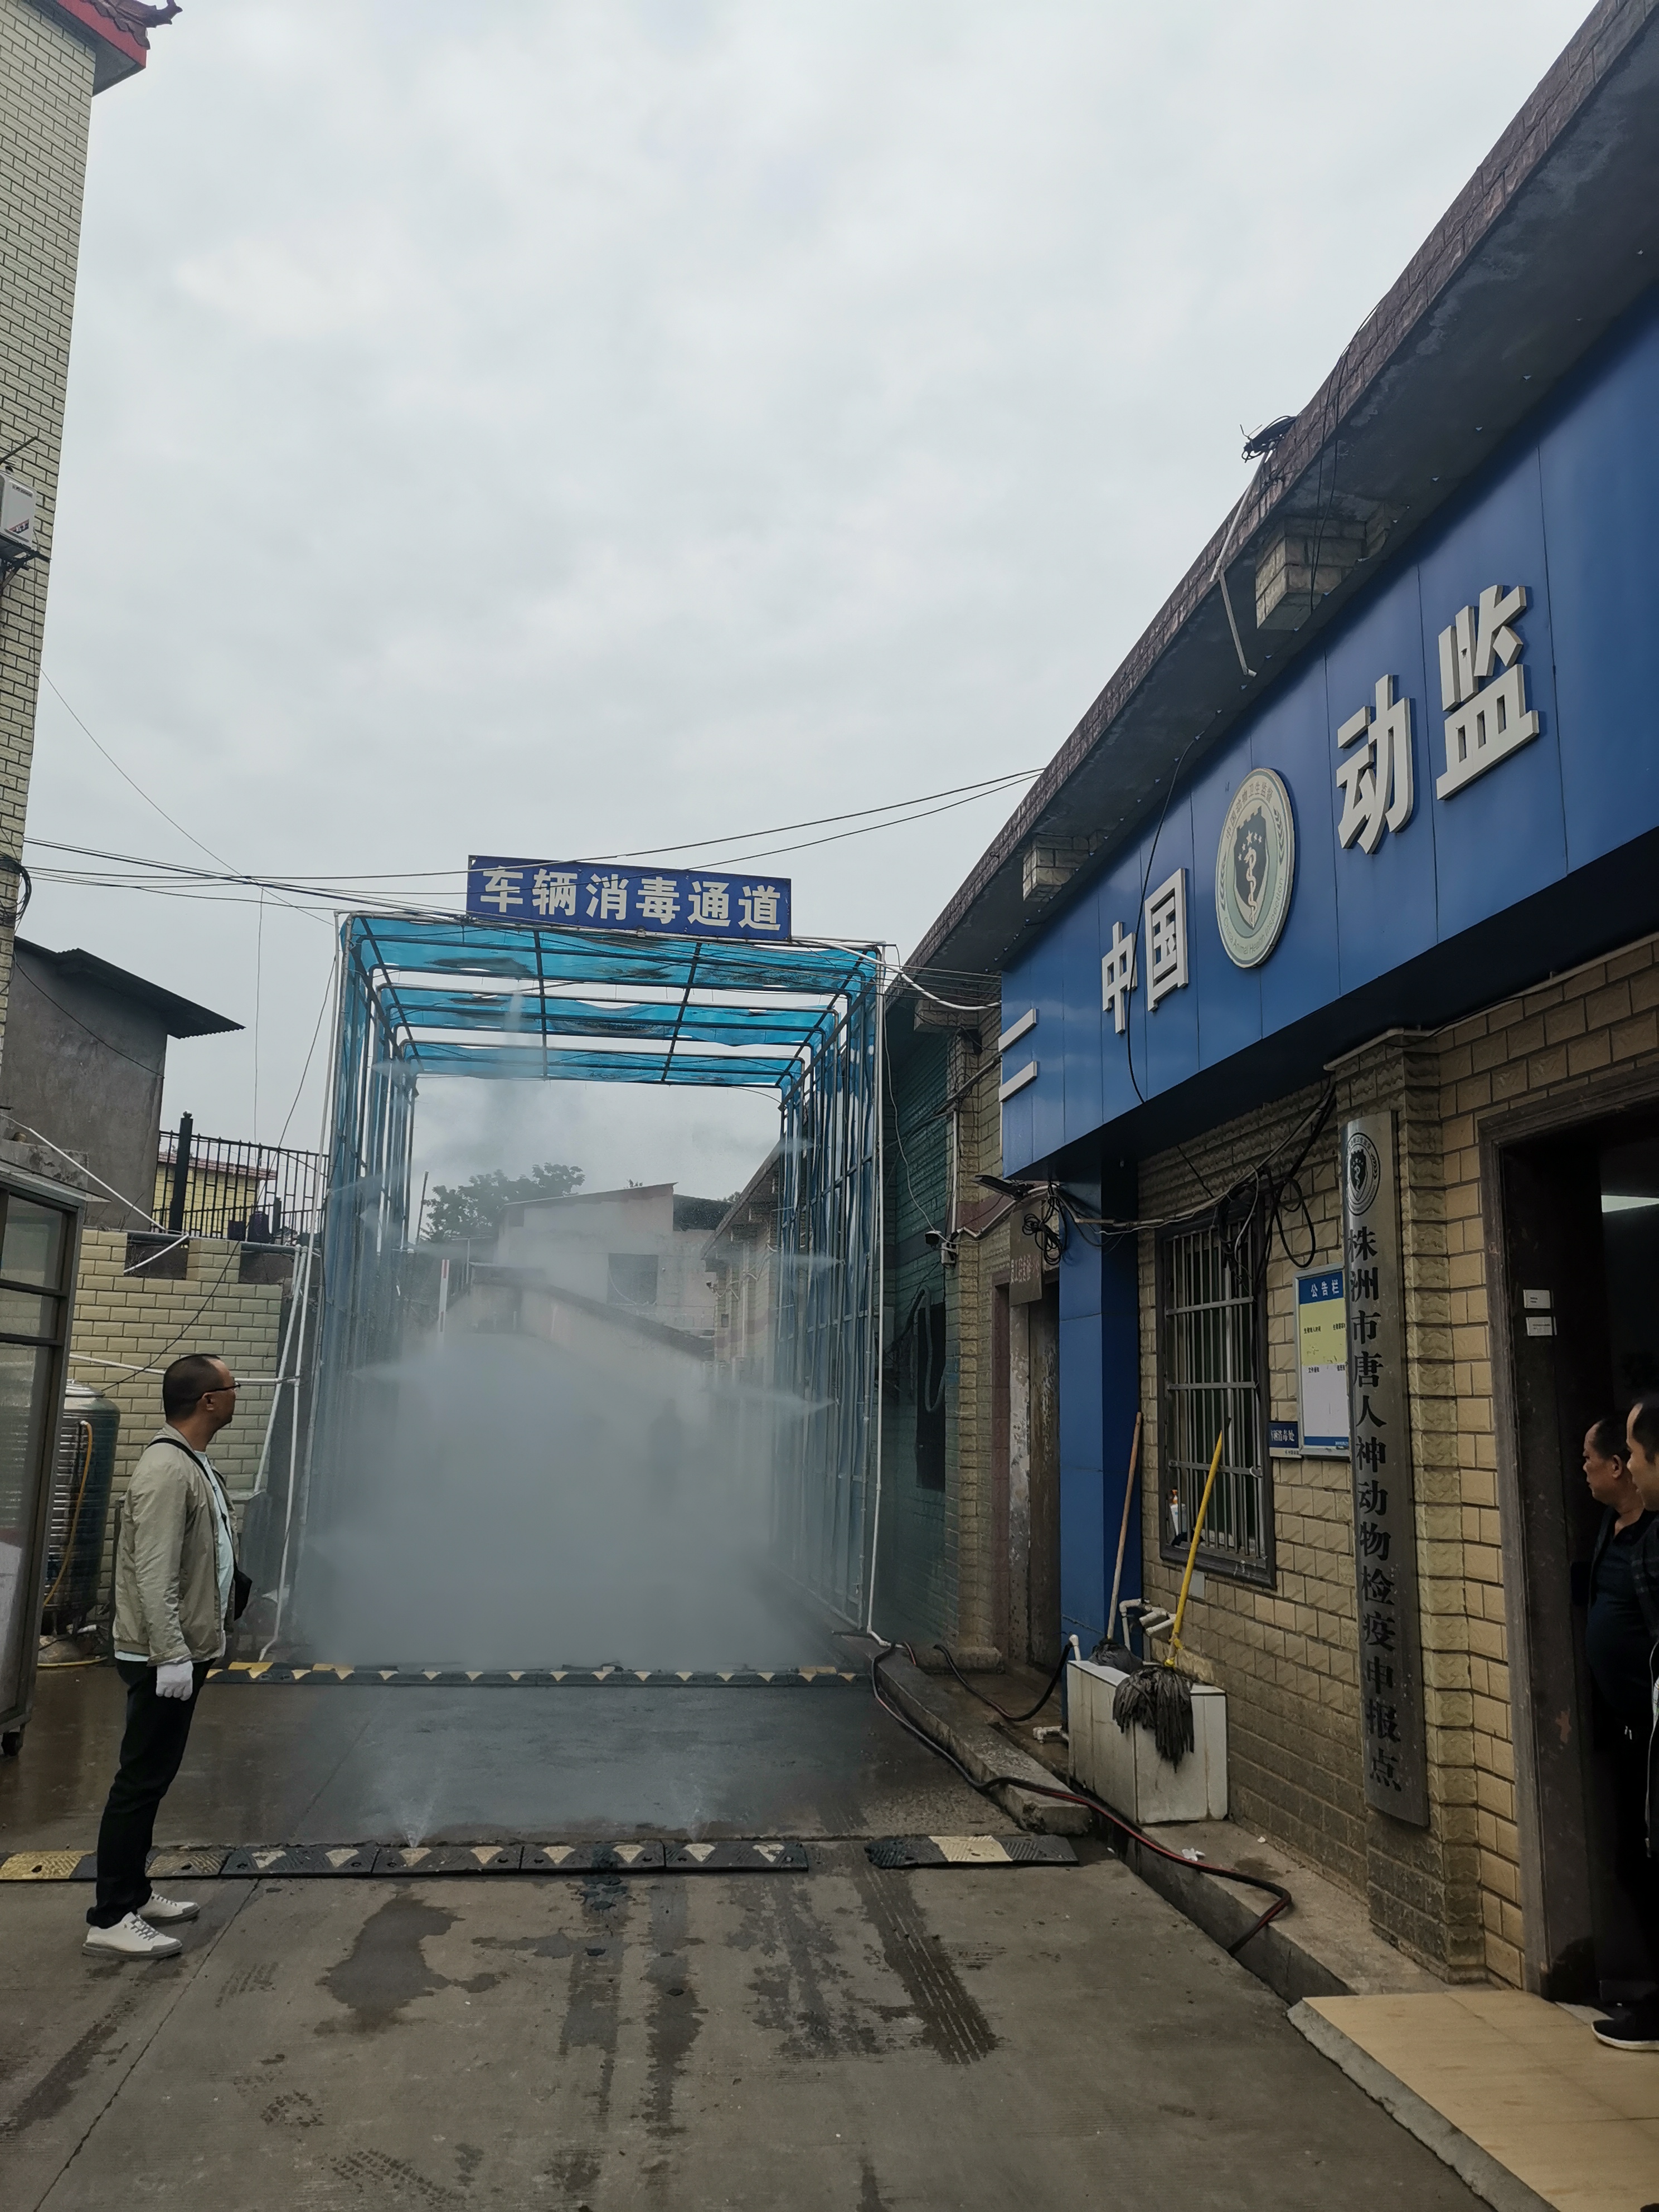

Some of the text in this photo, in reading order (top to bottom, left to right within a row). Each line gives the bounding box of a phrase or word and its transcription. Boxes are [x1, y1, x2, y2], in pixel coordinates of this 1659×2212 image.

[480, 866, 781, 930] 车辆消毒通道
[1311, 1279, 1340, 1298] 公告栏
[1347, 1227, 1401, 1791] 株洲市唐人神动物检疫申报点
